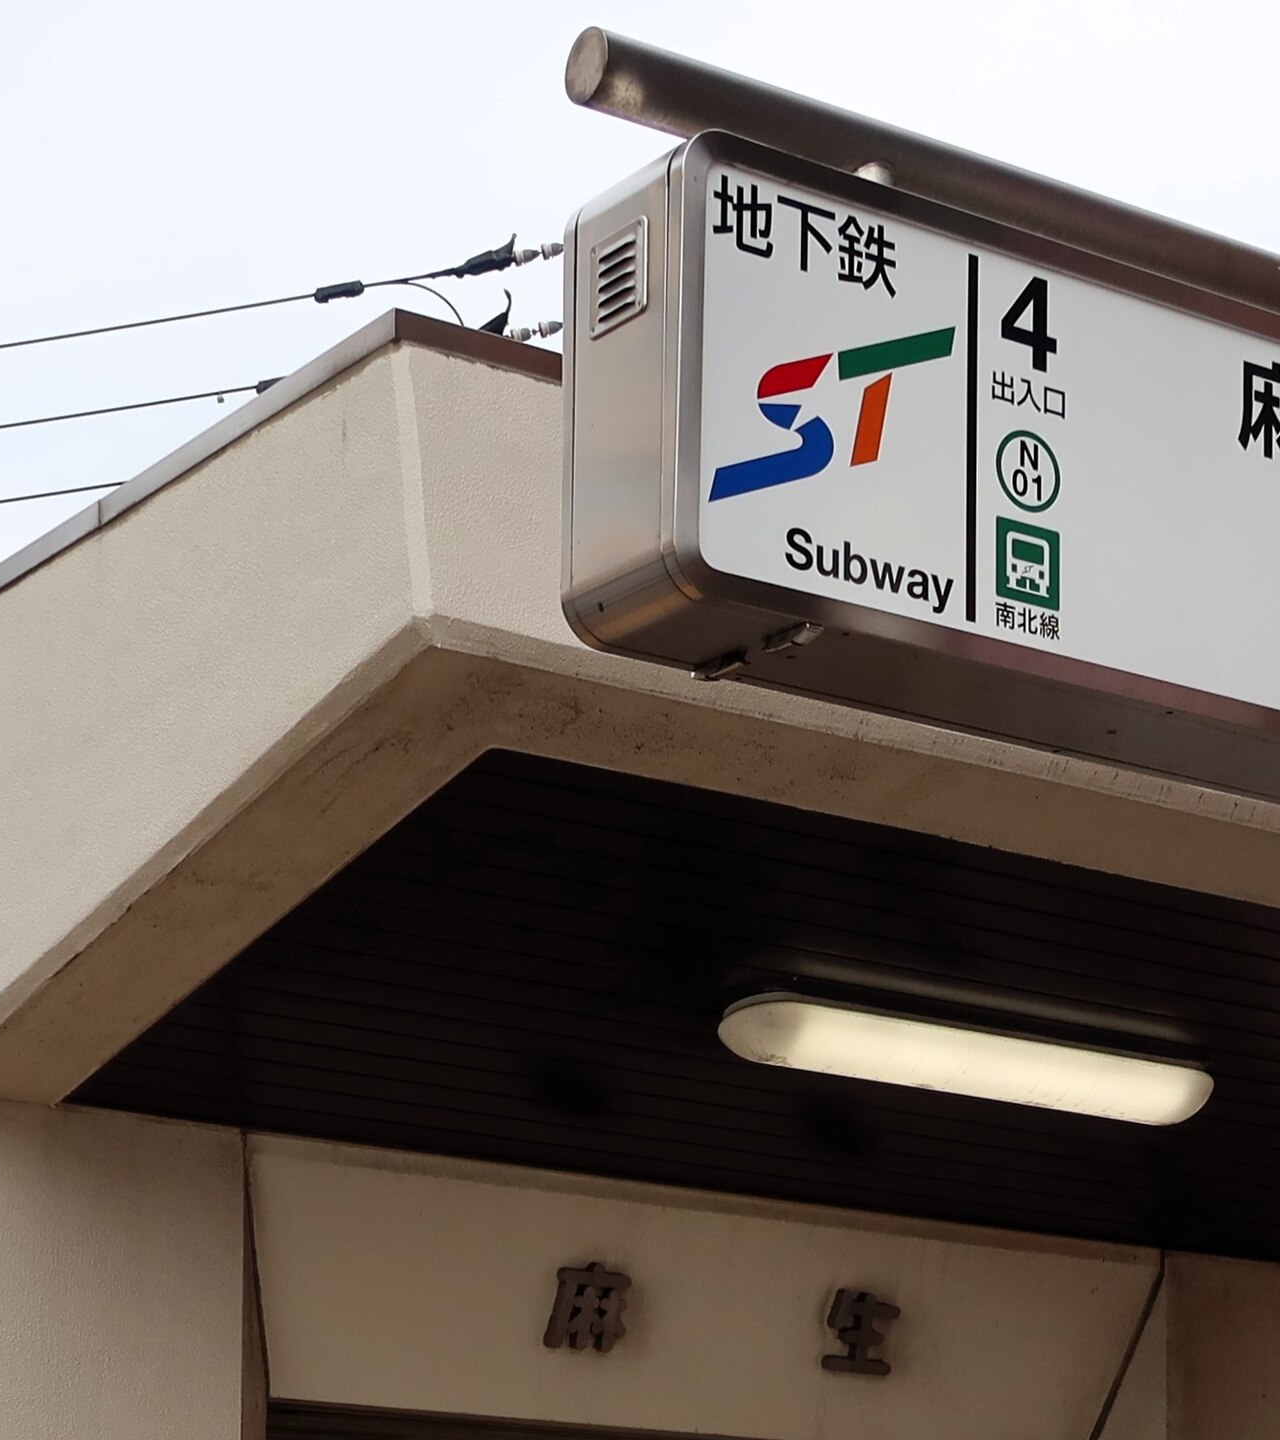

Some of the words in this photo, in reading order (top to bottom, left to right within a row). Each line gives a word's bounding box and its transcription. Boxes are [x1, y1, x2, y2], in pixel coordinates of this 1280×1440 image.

[713, 174, 897, 299] 地下鉄
[1001, 276, 1057, 373] 4
[991, 371, 1066, 420] 出入口
[1019, 440, 1039, 471] N
[1011, 469, 1042, 501] 01
[785, 527, 954, 614] Subway
[995, 602, 1061, 640] 南北線
